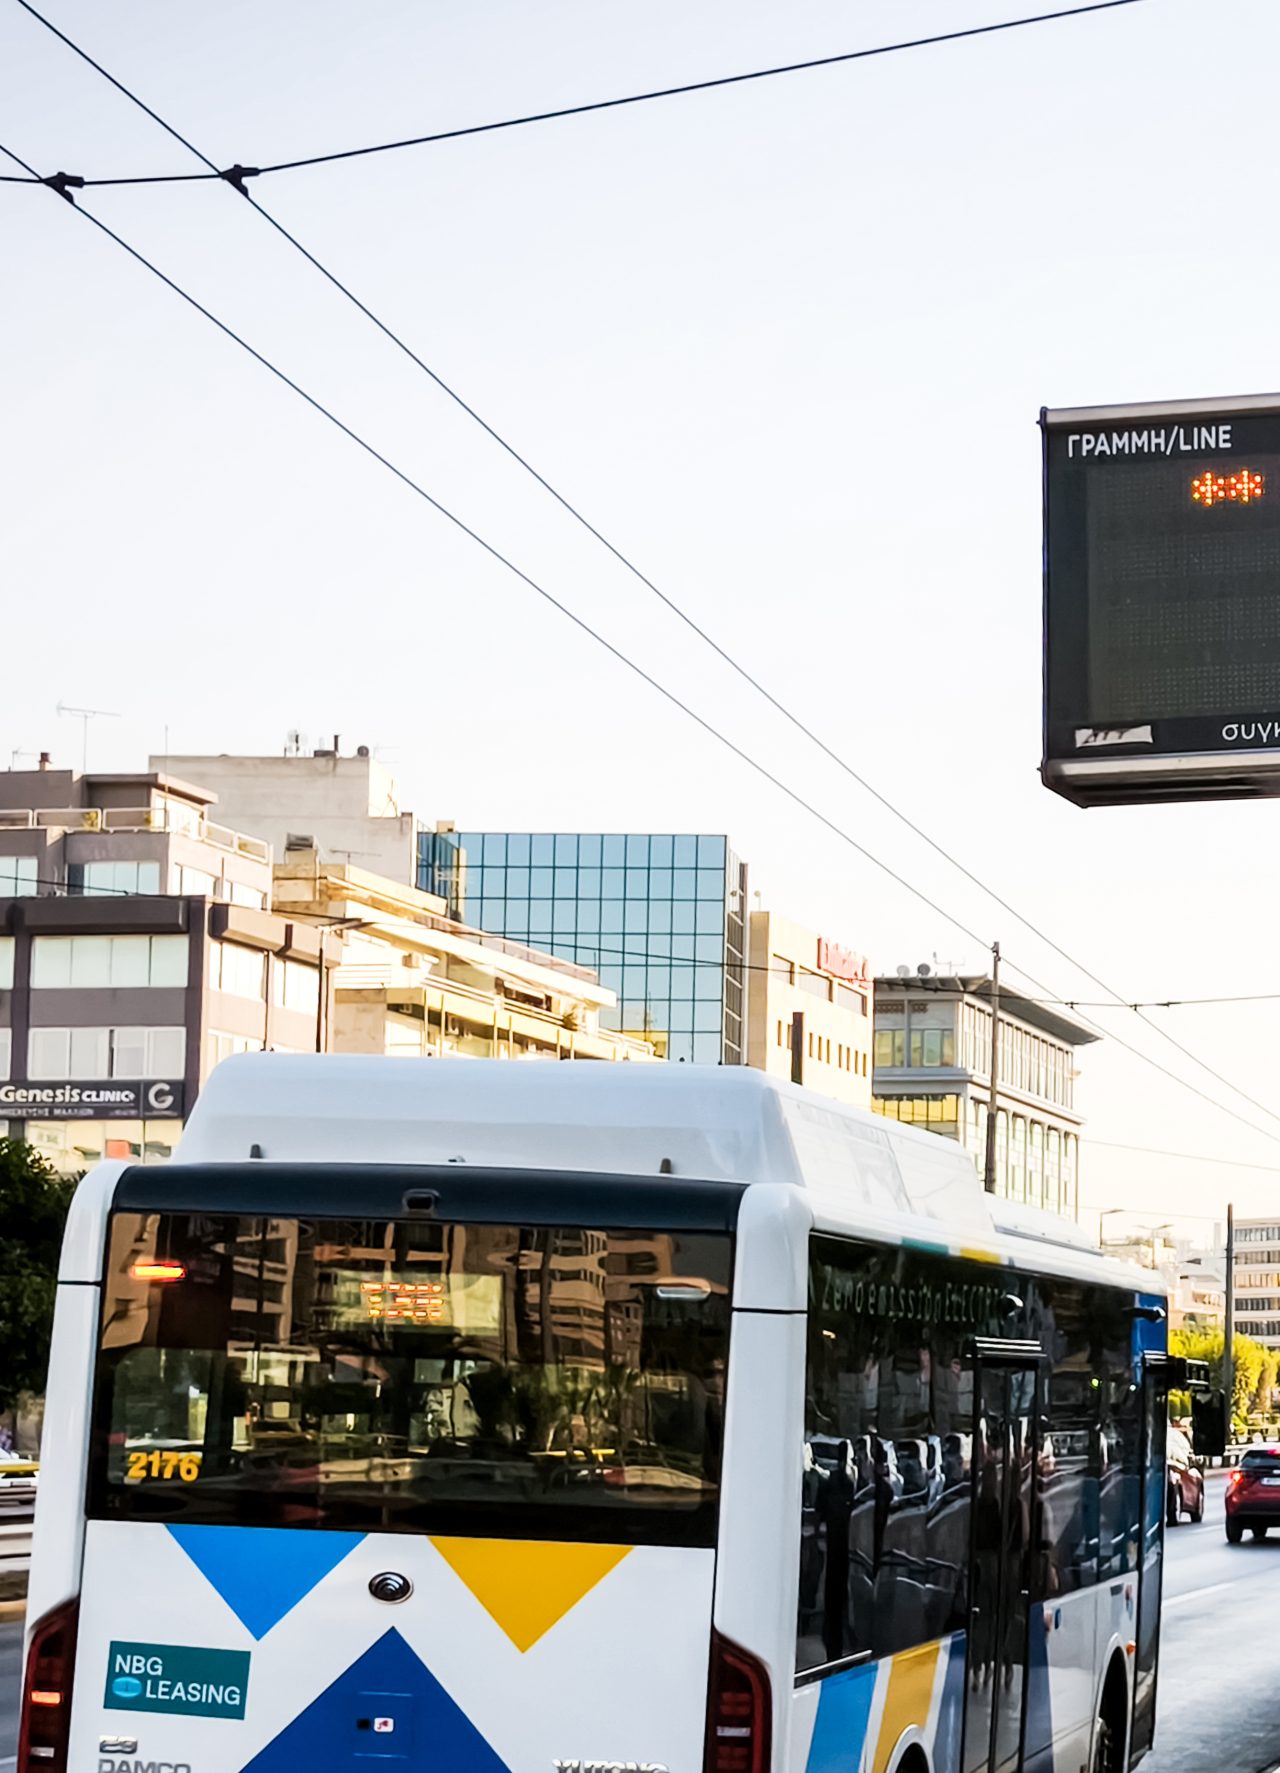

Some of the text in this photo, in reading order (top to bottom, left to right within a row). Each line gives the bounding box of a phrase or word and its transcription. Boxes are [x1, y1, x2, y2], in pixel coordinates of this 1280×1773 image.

[1067, 424, 1233, 458] ΓΡΑΜΜΗ/LINE
[0, 1085, 81, 1103] Genesis
[127, 1450, 202, 1481] 2176
[115, 1654, 163, 1676] NBG
[145, 1679, 241, 1706] LEASING
